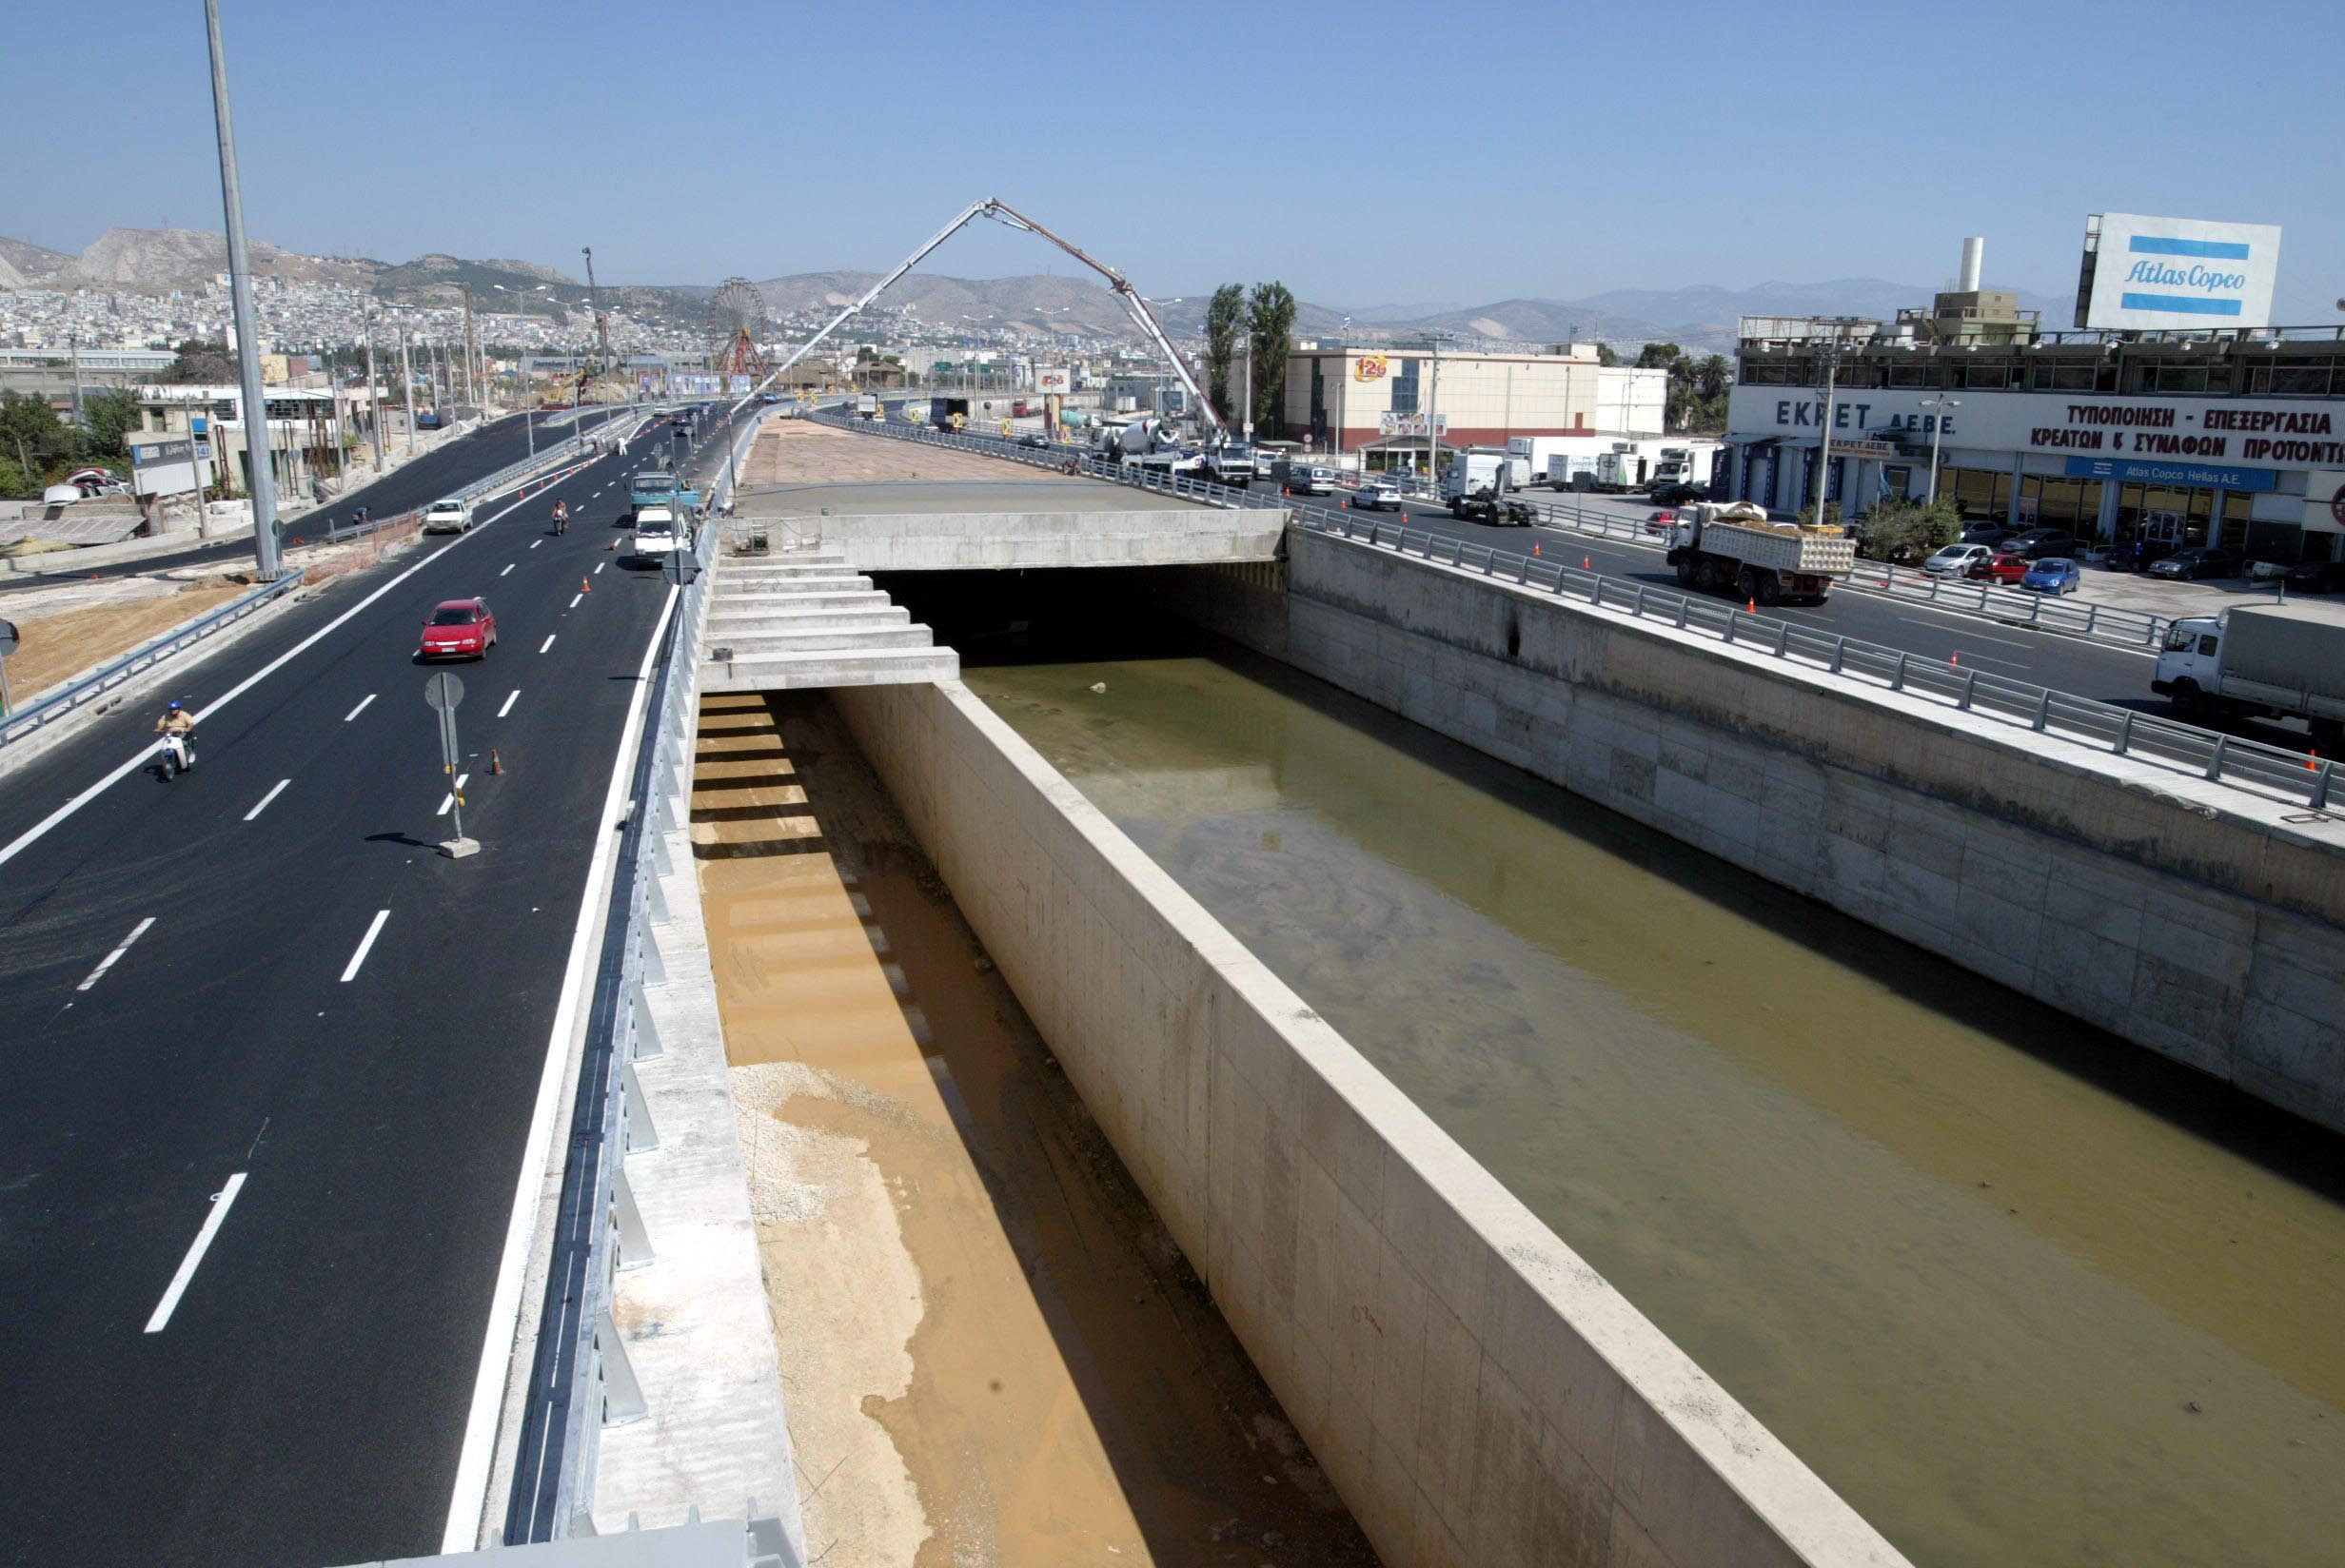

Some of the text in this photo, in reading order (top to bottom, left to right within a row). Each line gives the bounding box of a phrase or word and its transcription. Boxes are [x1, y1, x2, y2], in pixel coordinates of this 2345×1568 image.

[2124, 260, 2246, 292] Atlas Copco
[2067, 404, 2176, 427] ΤΥΠΟΠΟΙΗΣΗ
[2203, 409, 2332, 435] ΕΠΕΞΕΡΓΑΣΙΑ
[2030, 427, 2103, 450] ΚΡΕΑΤΩΝ
[2133, 433, 2227, 457] ΣΥΝΑΦΩΝ
[2125, 465, 2150, 477] Atlas
[2151, 467, 2184, 480] Copco
[2188, 470, 2218, 483] Hellas
[2220, 474, 2241, 485] A.E.
